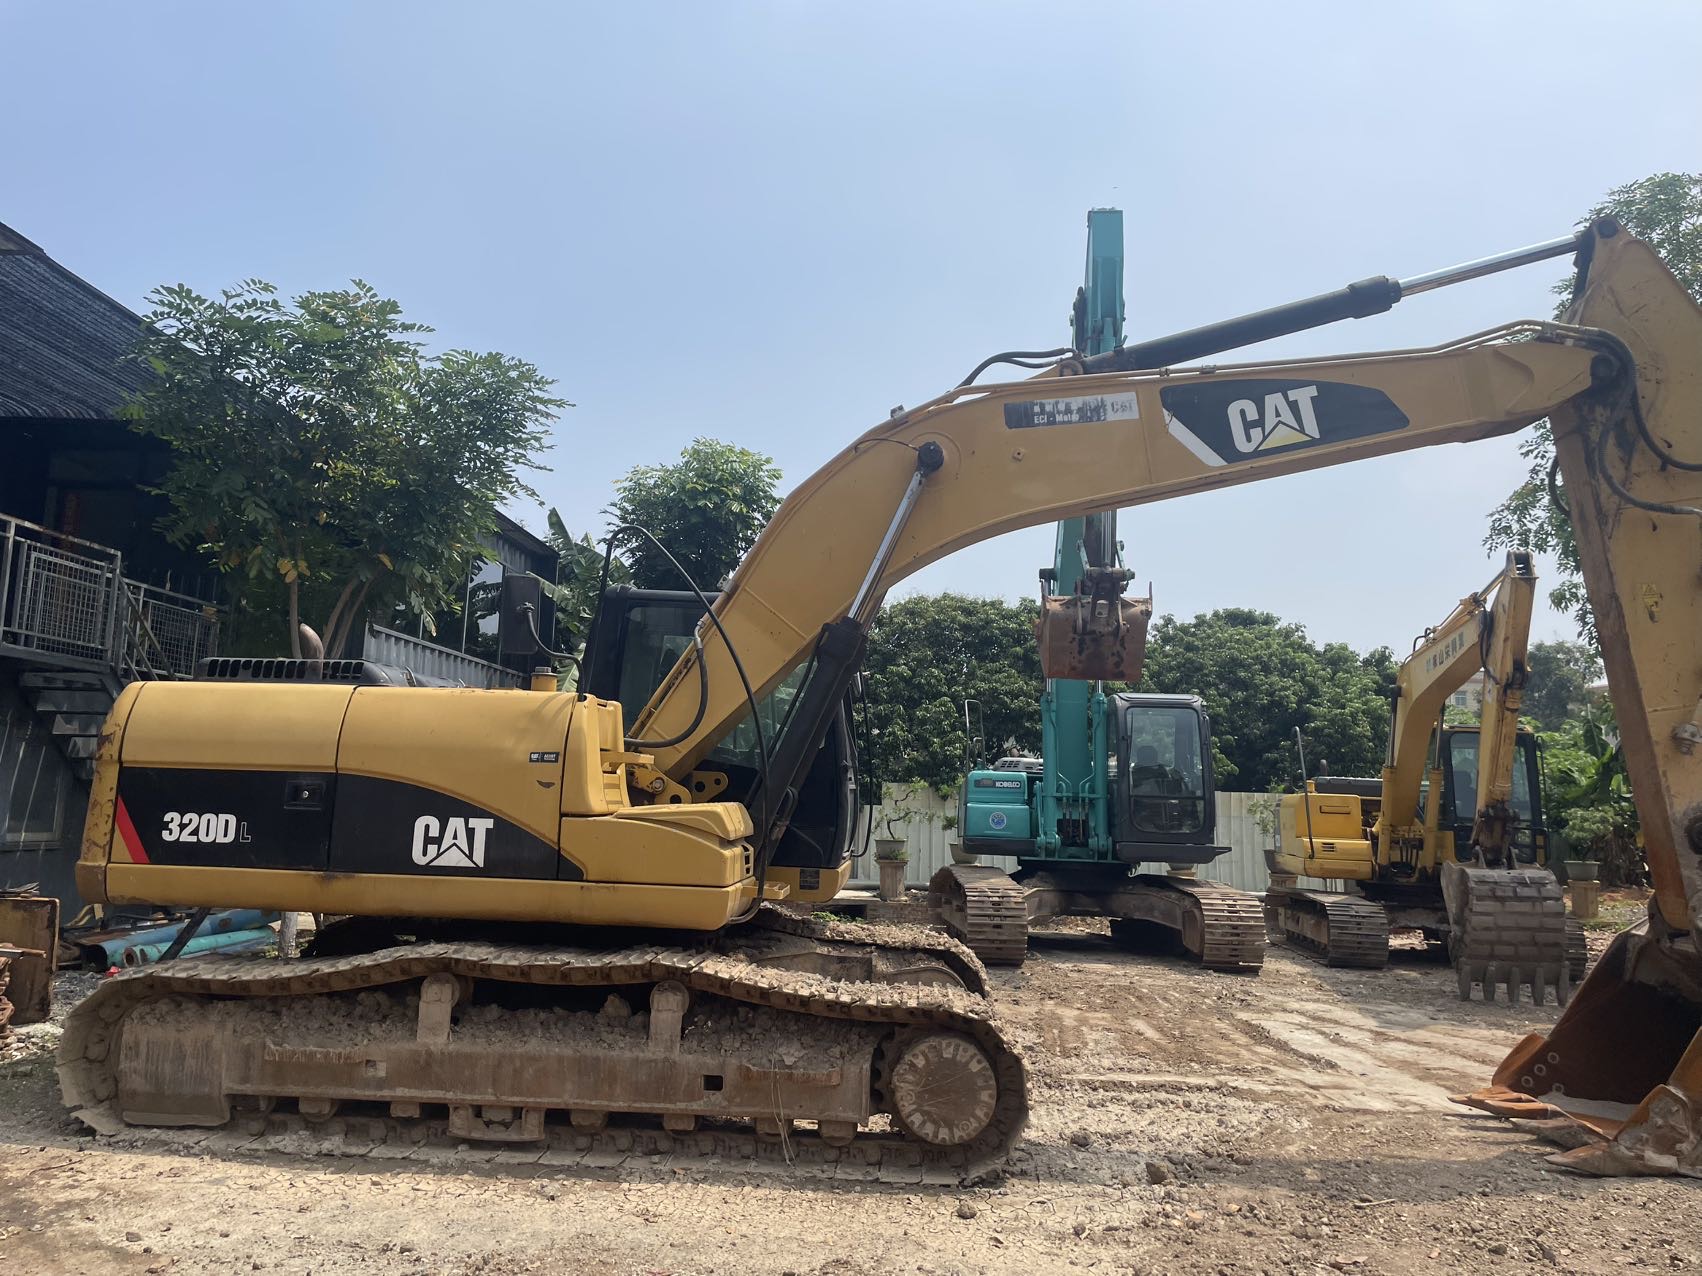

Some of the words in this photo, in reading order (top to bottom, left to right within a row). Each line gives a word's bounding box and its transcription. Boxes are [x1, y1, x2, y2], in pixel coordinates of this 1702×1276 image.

[1034, 415, 1048, 425] ECI
[1227, 385, 1321, 453] CAT
[161, 811, 237, 843] 320D
[239, 821, 252, 842] L
[411, 815, 494, 868] CAT
